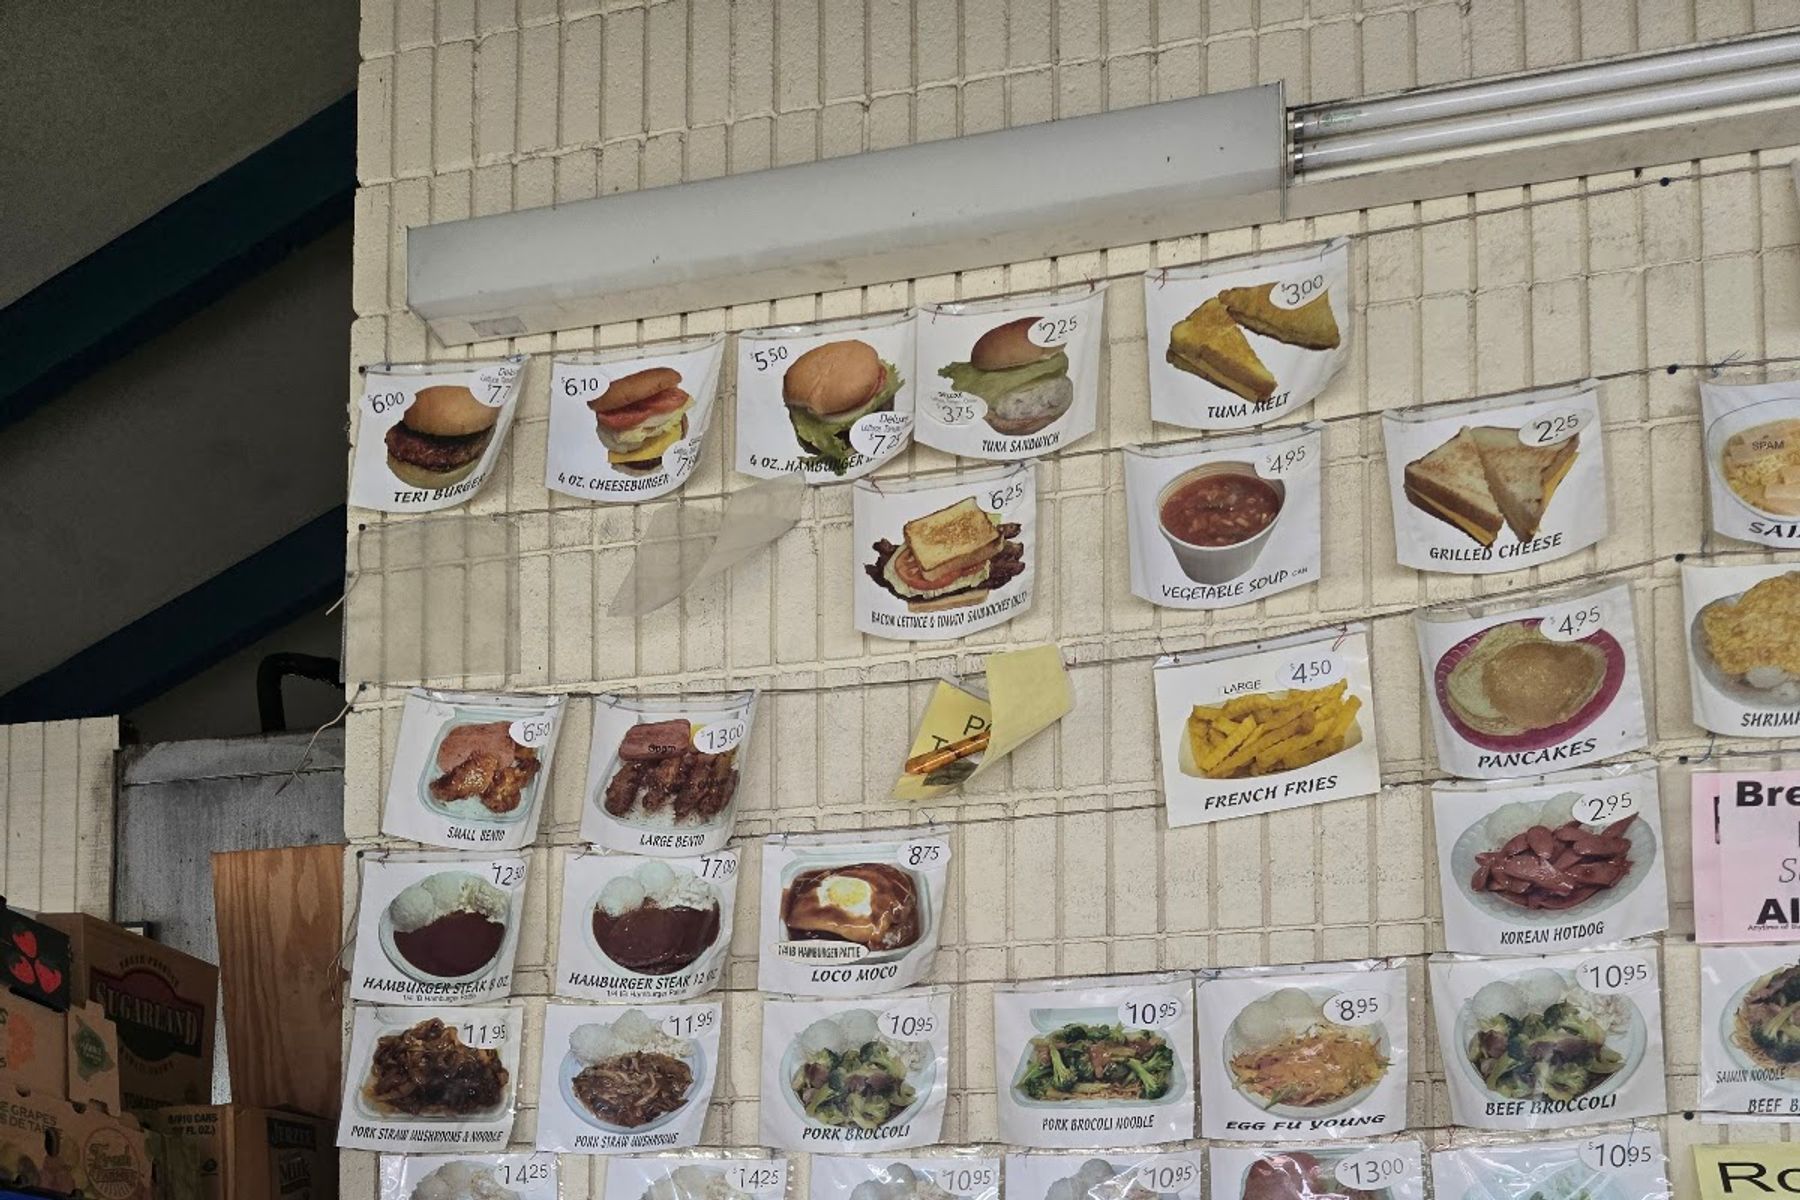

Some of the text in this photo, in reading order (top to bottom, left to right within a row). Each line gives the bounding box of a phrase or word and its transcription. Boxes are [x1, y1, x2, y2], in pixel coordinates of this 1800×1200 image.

[1208, 392, 1290, 418] TUNA MELT
[982, 439, 1007, 452] TUNA
[1752, 440, 1785, 451] SPAM
[394, 473, 486, 503] TERI BURGER
[589, 474, 670, 492] CHEESEBURGER
[1430, 532, 1563, 561] GRILLED CHEESE
[1162, 583, 1243, 600] VEGETABLE
[1250, 570, 1288, 593] SOUP
[1224, 680, 1261, 694] LARGE
[1478, 738, 1597, 769] PANCAKES
[1205, 775, 1337, 810] FRENCH FRIES
[447, 827, 505, 841] SMALL BENTO
[639, 834, 704, 847] LARGE BENTO
[1500, 921, 1605, 944] KOREAN HOTDOG
[569, 973, 689, 990] HAMBURGER STEAK
[812, 965, 898, 982] LOCO MOCO
[363, 977, 487, 993] HAMBURGER STEAK
[96, 982, 197, 1046] SUGARLAND
[1485, 1094, 1616, 1116] BEEF BROCCOLI
[11, 1106, 57, 1126] GRAPES
[1043, 1115, 1154, 1131] PORK BROCOLI NOODLE
[1226, 1114, 1386, 1131] EGG FU YOUNG
[803, 1125, 910, 1140] PORK BROCCOLI
